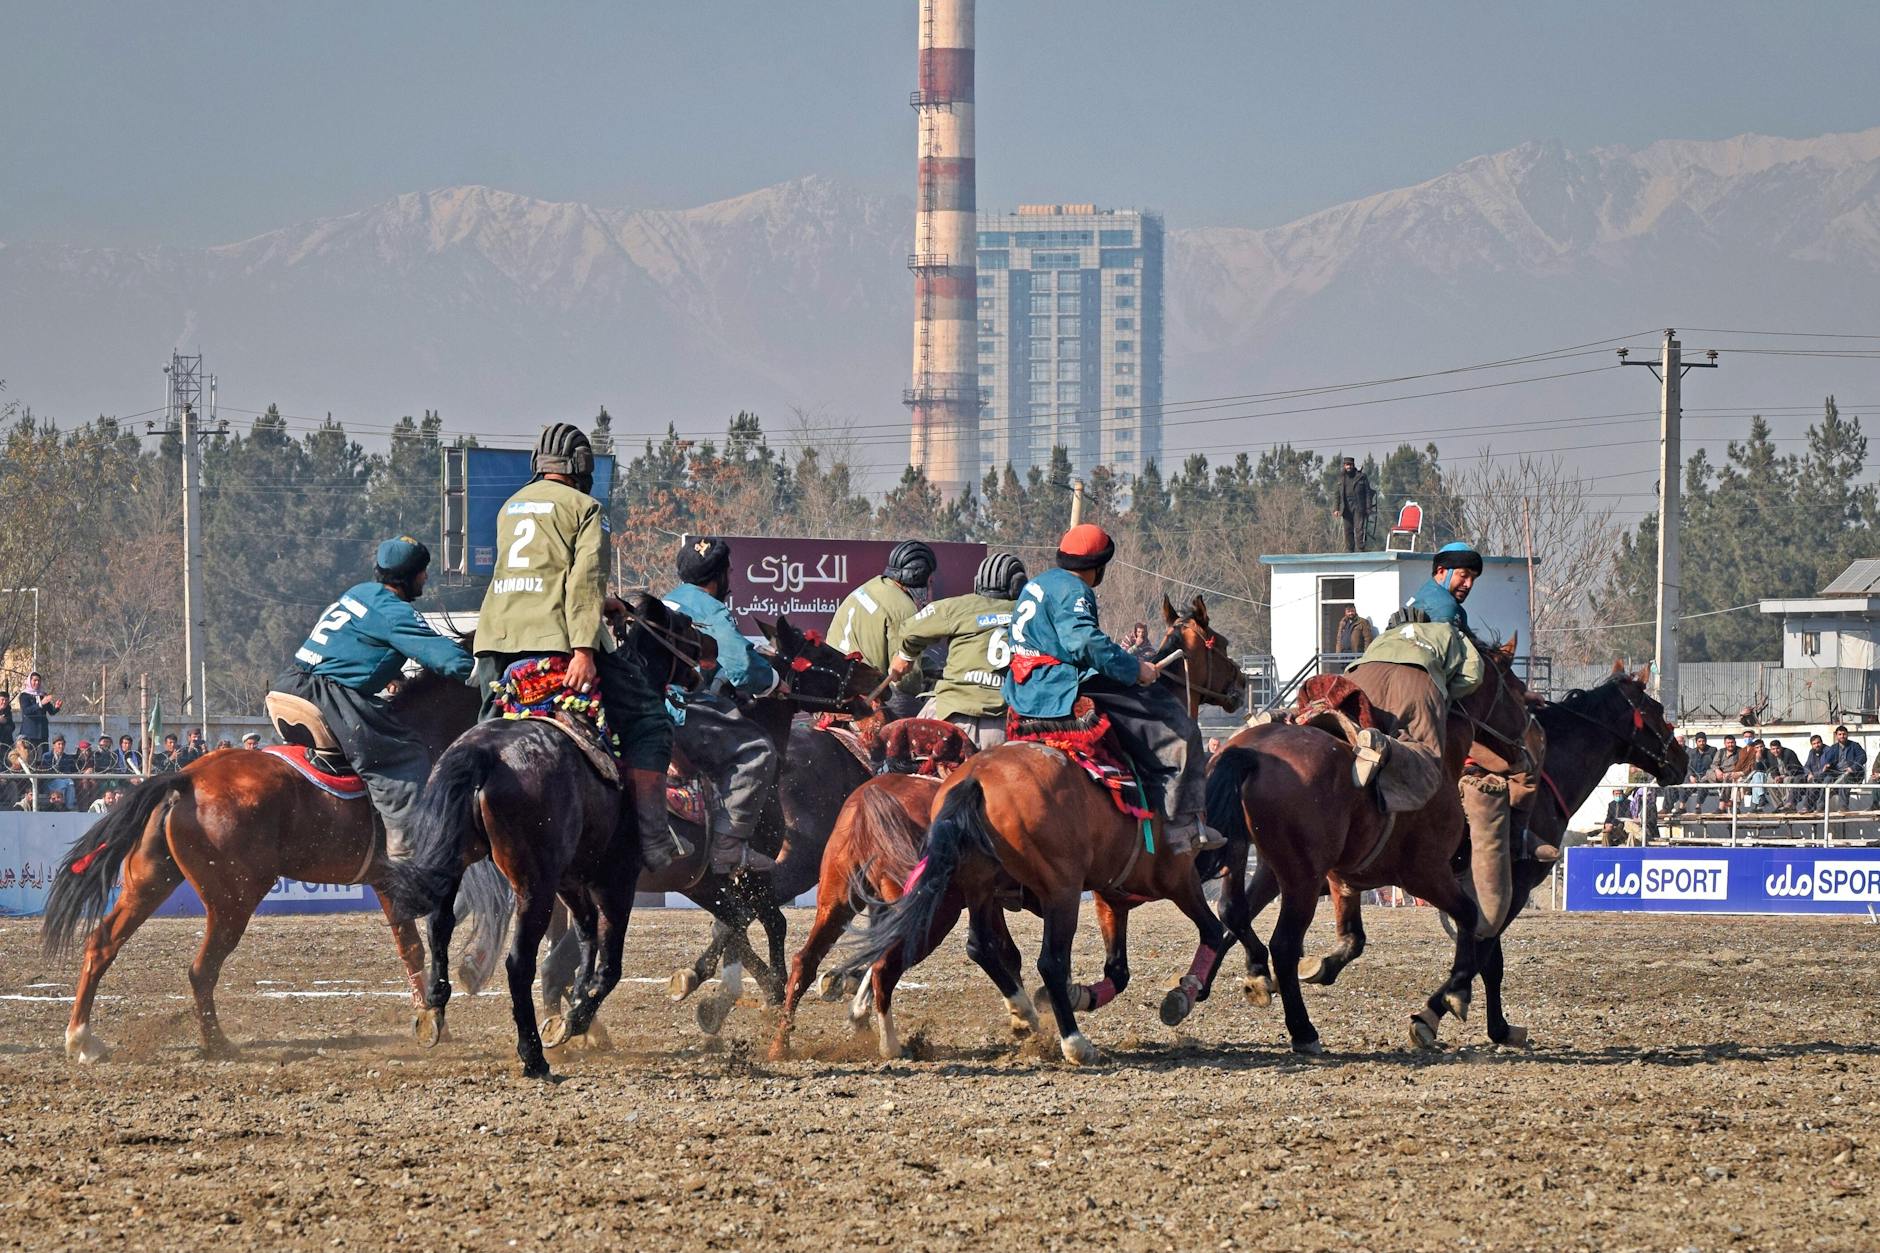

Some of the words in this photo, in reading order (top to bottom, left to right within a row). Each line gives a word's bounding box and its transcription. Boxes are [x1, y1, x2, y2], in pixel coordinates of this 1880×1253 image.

[507, 518, 536, 568] 2
[1012, 600, 1037, 643] 2
[987, 627, 1011, 669] 6
[964, 671, 1005, 688] KUND
[1645, 868, 1722, 893] SPORT
[1818, 869, 1880, 894] SPOR
